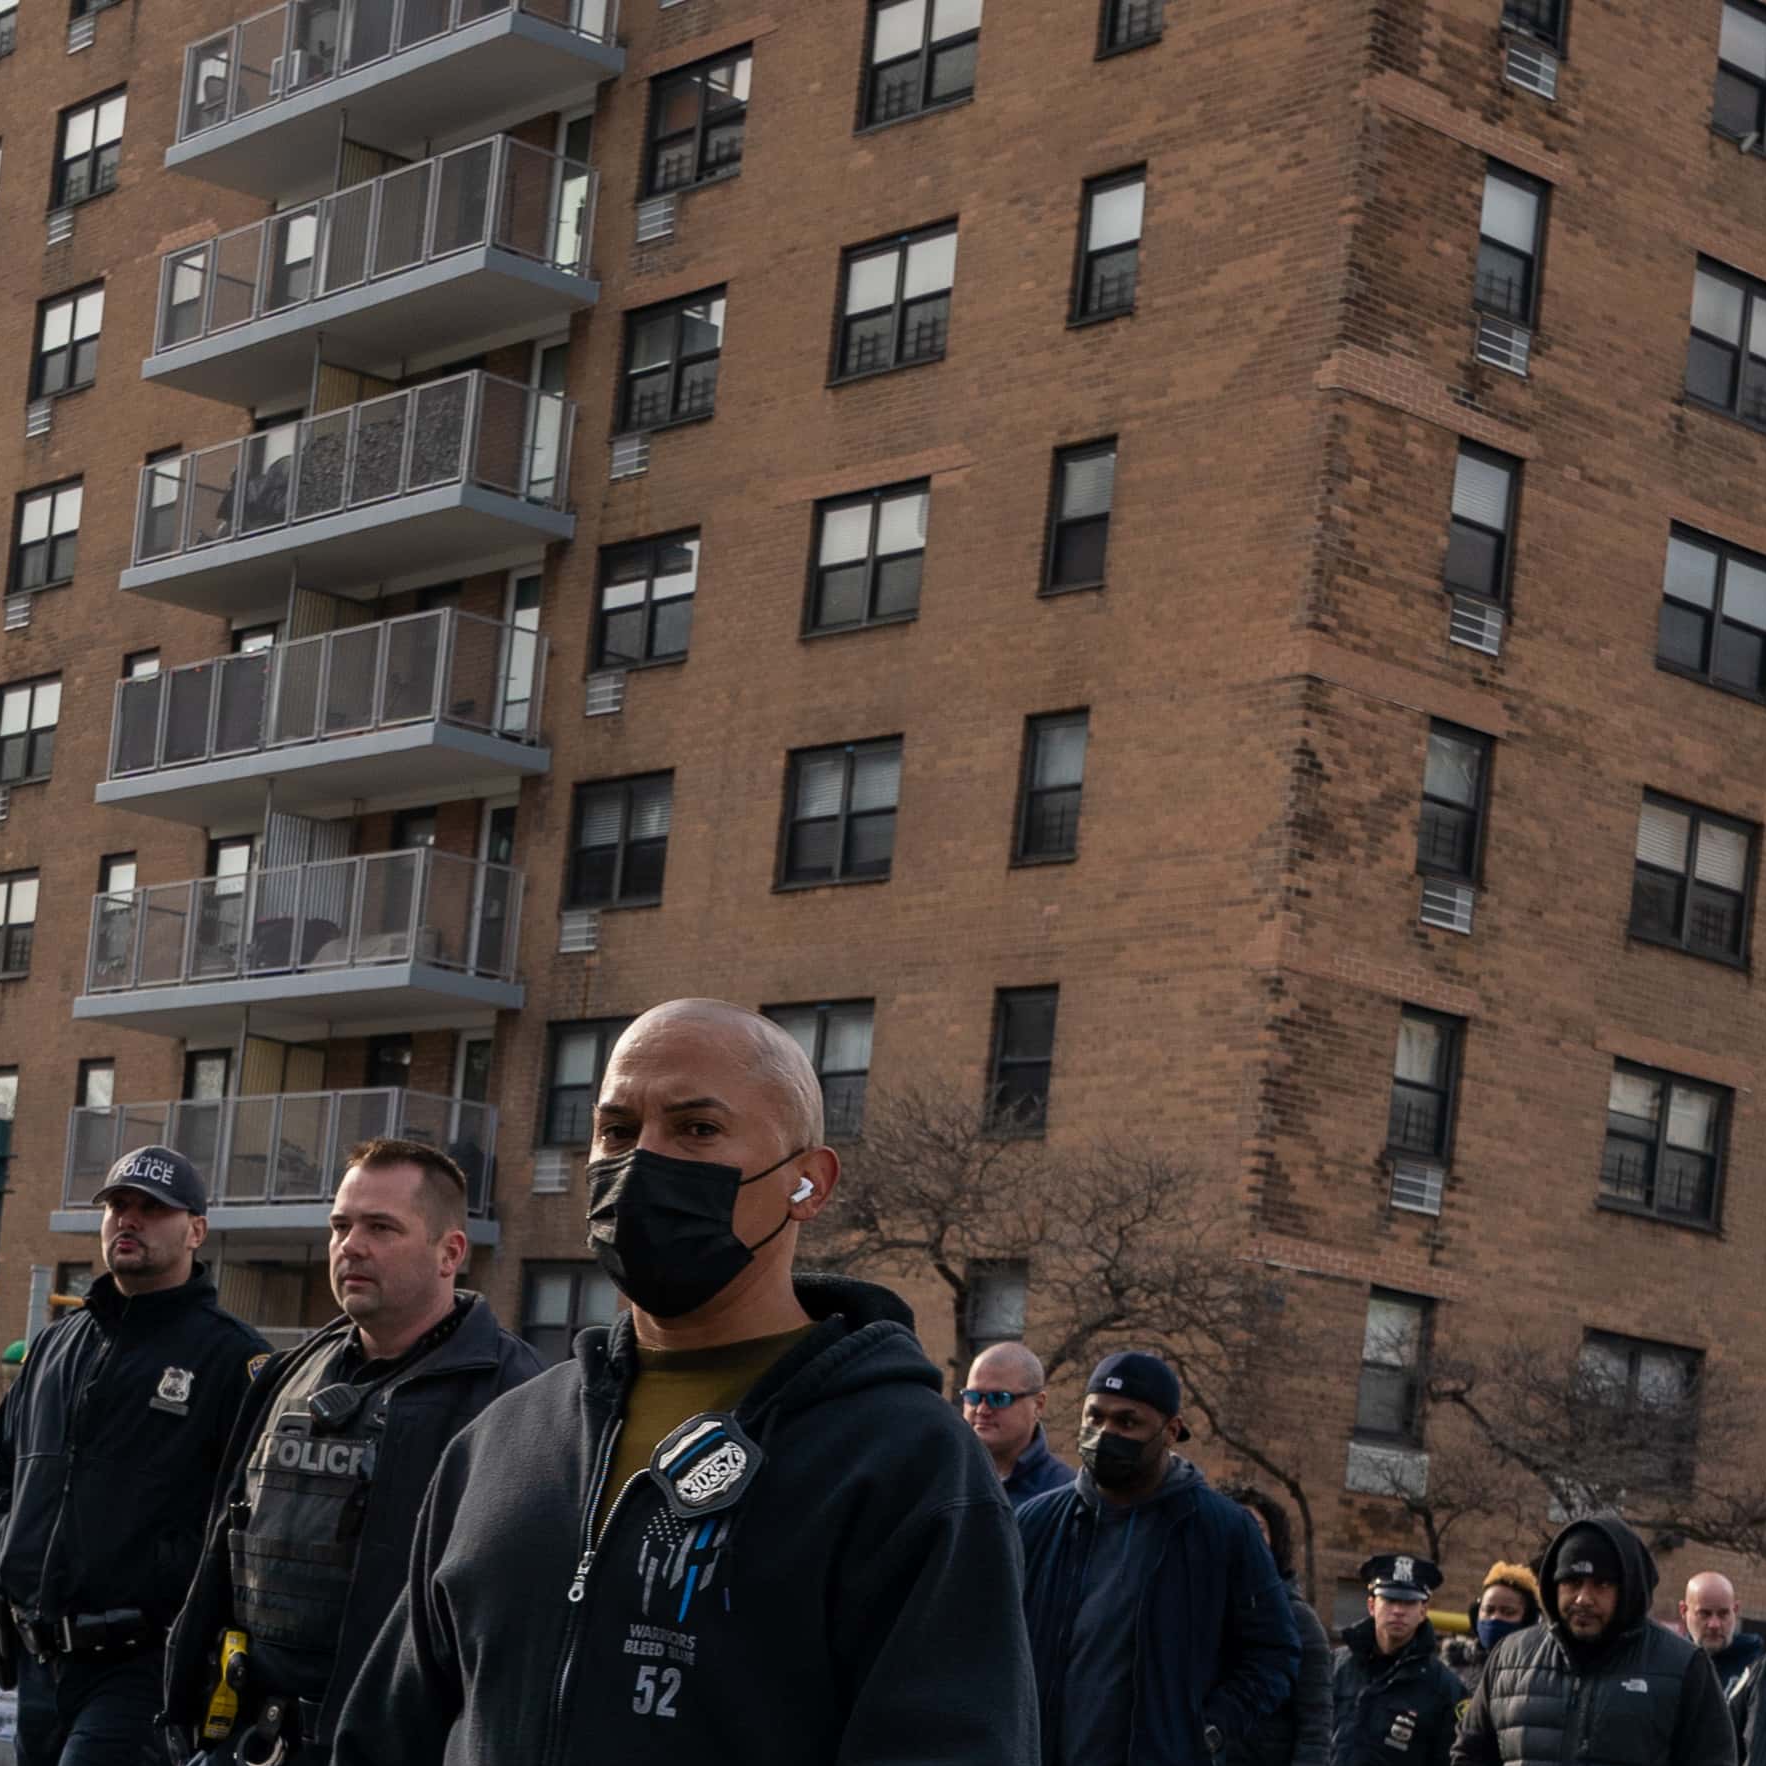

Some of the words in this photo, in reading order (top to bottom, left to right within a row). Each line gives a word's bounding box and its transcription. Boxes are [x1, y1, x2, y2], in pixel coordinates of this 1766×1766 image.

[114, 1161, 174, 1185] POLICE
[683, 1447, 739, 1498] 30357
[623, 1639, 665, 1656] BLEED
[630, 1623, 697, 1650] WARRIORS
[632, 1665, 682, 1717] 52
